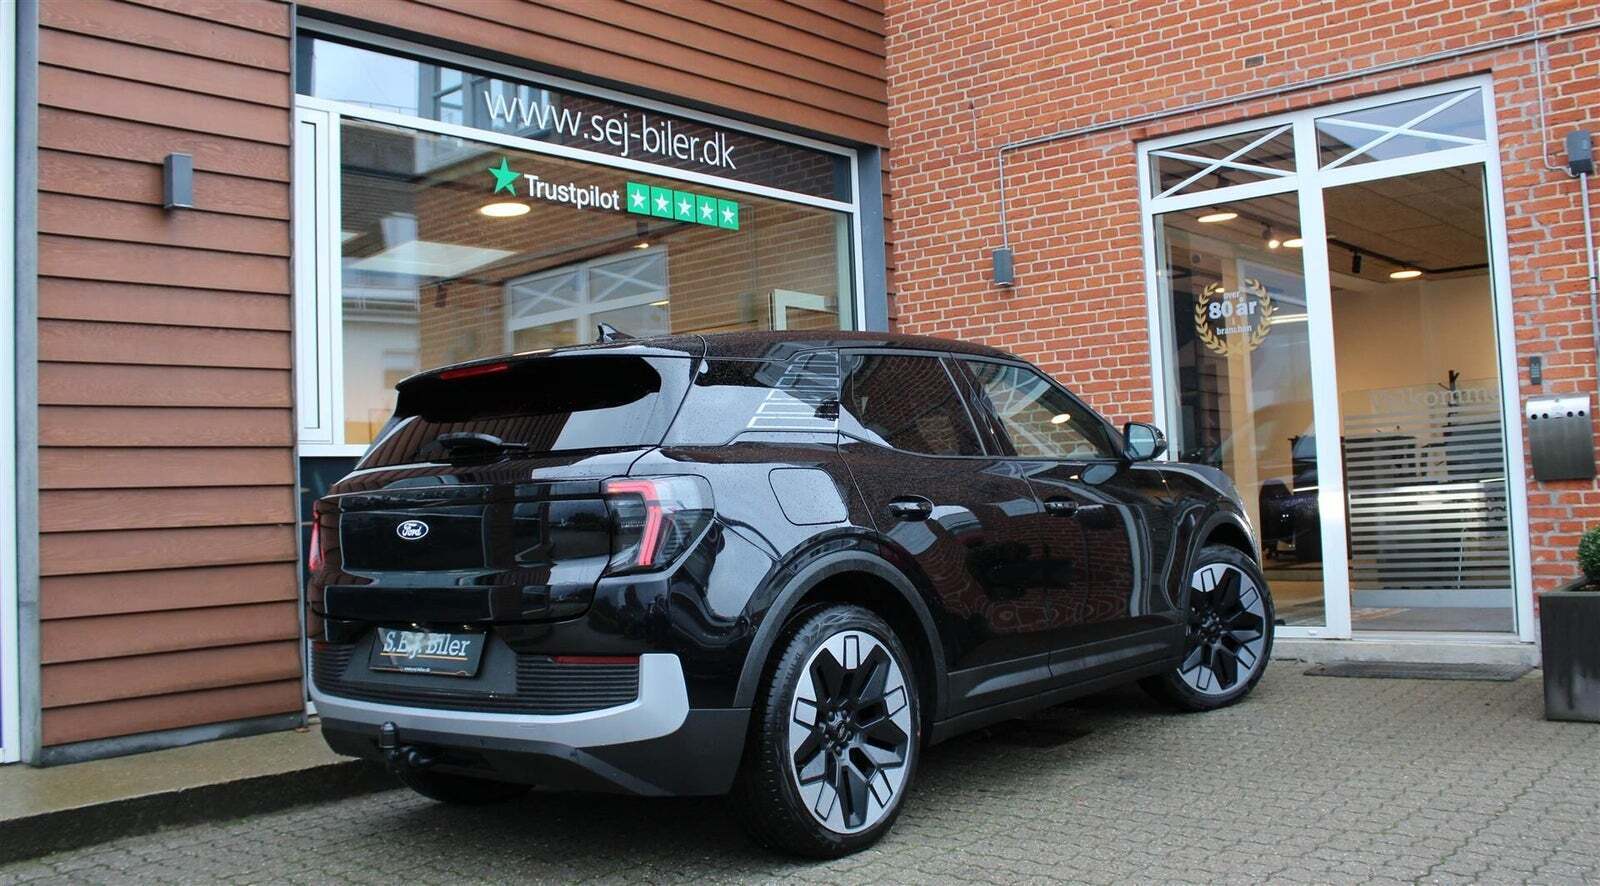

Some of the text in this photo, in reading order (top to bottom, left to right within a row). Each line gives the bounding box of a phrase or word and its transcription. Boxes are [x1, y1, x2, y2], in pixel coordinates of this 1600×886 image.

[484, 90, 737, 169] www.sej-biler.dk
[524, 173, 620, 210] Trustpilot
[1208, 301, 1233, 319] 80
[402, 523, 422, 536] Ford
[426, 633, 470, 656] Biler
